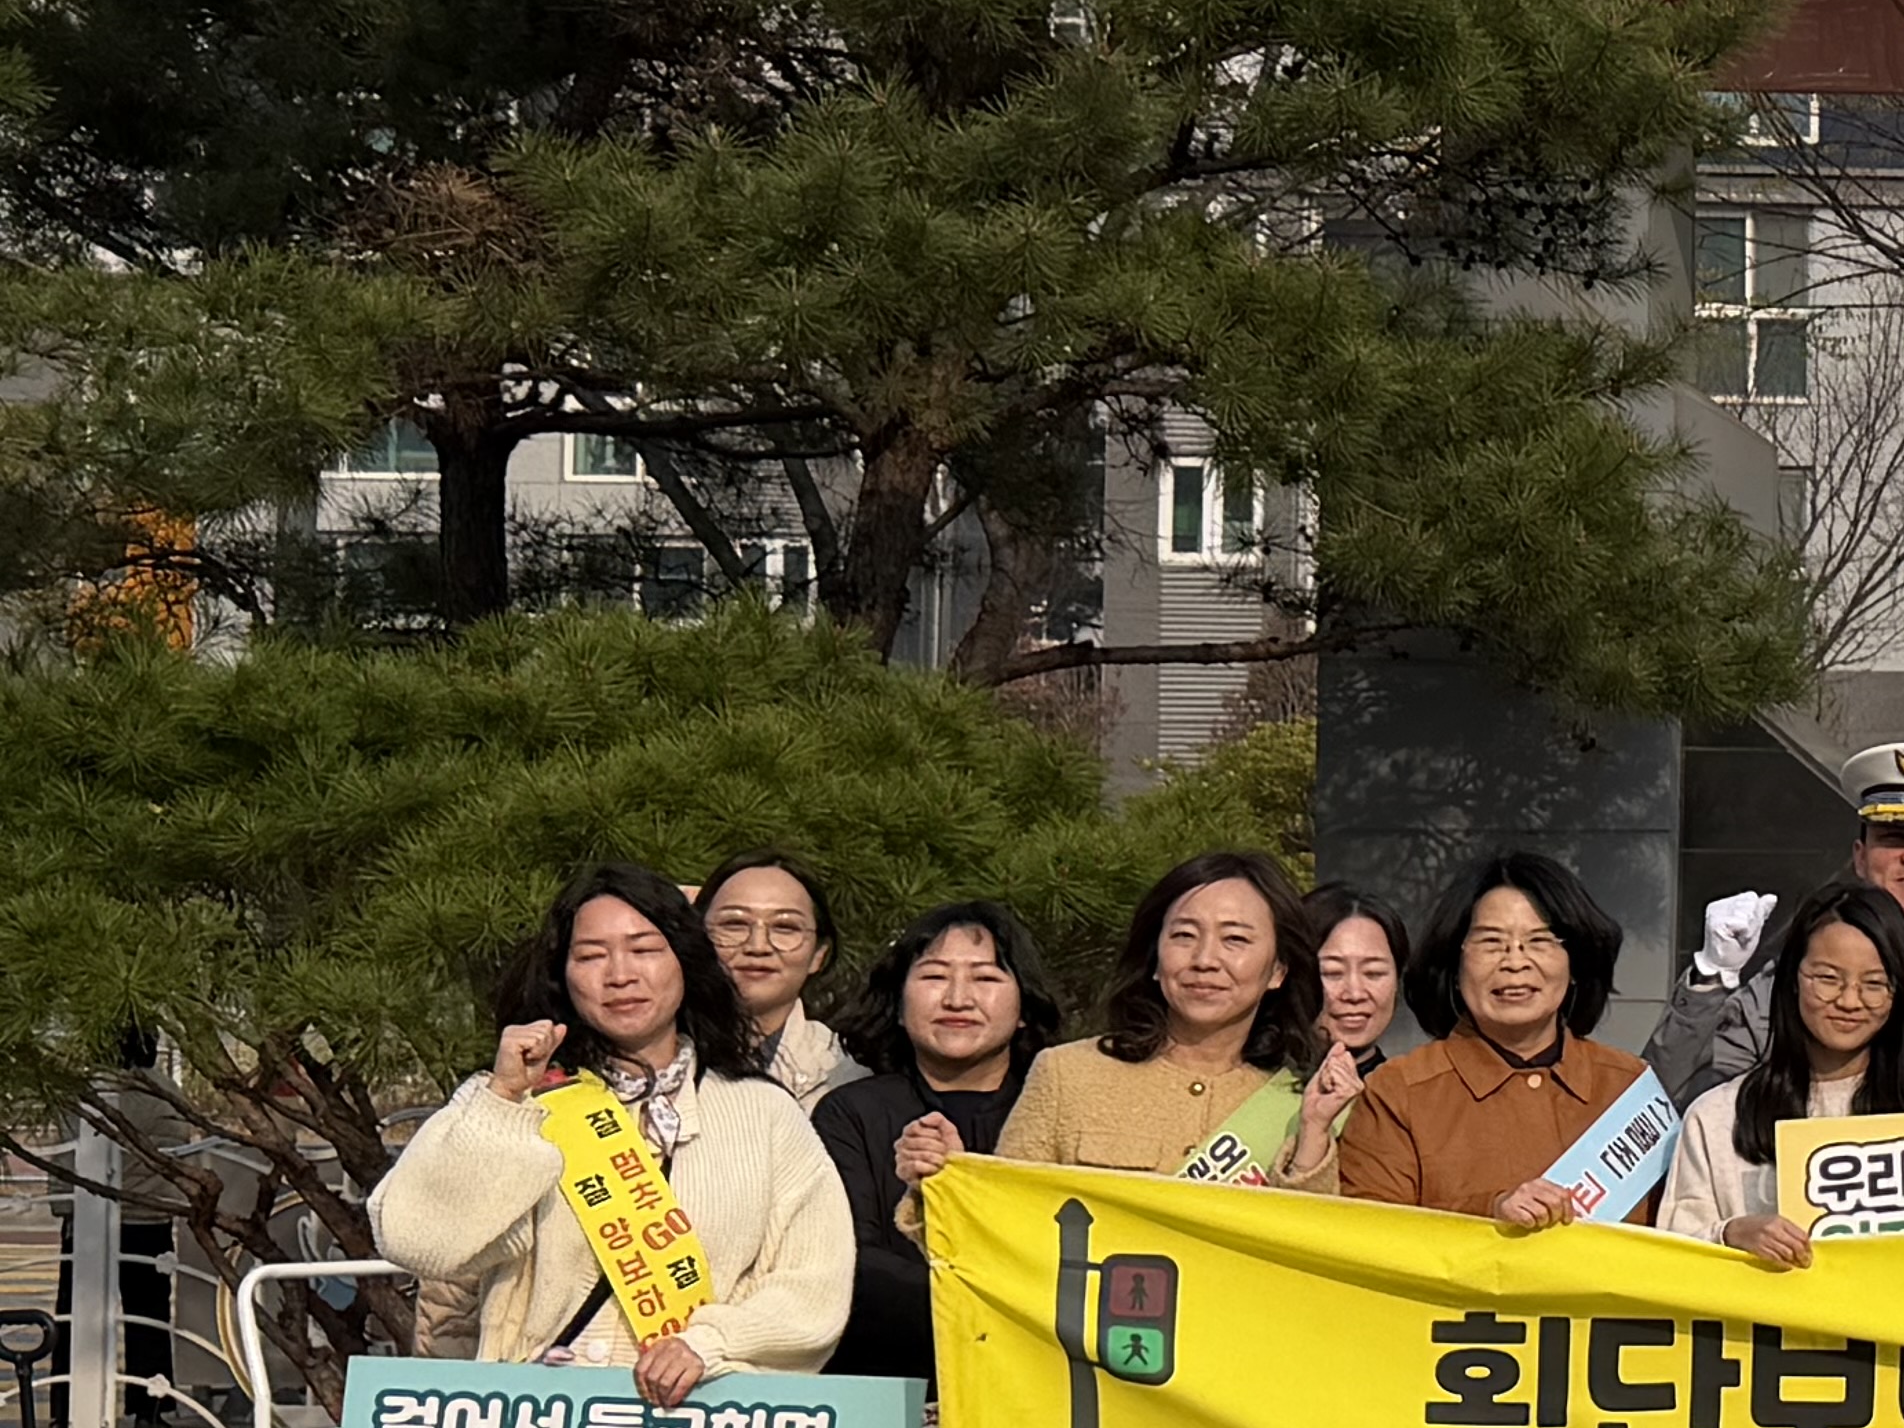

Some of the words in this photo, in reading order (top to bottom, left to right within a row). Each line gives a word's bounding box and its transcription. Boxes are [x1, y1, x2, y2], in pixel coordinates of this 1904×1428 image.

[585, 1107, 623, 1139] 잘
[574, 1174, 612, 1208] 잘
[667, 1255, 700, 1290] 잘
